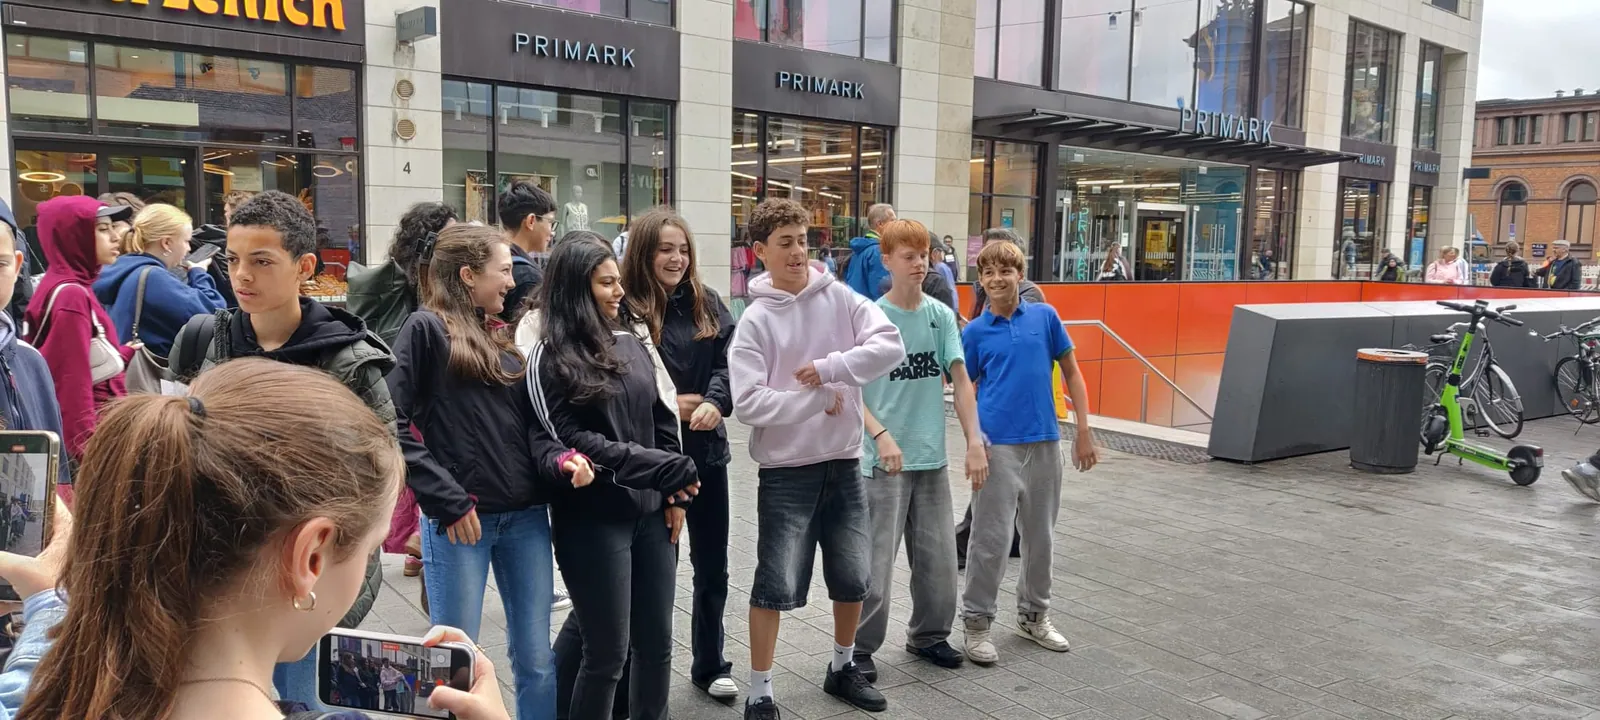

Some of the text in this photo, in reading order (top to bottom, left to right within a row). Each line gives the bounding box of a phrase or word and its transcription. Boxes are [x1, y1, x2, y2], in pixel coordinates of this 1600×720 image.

[514, 32, 636, 68] PRIMARK
[779, 71, 865, 99] PRIMARK
[1181, 107, 1274, 144] PRIMARK
[402, 161, 411, 175] 4
[1078, 207, 1089, 280] PRIMAR
[890, 363, 941, 382] PARIS
[907, 350, 940, 367] 10K
